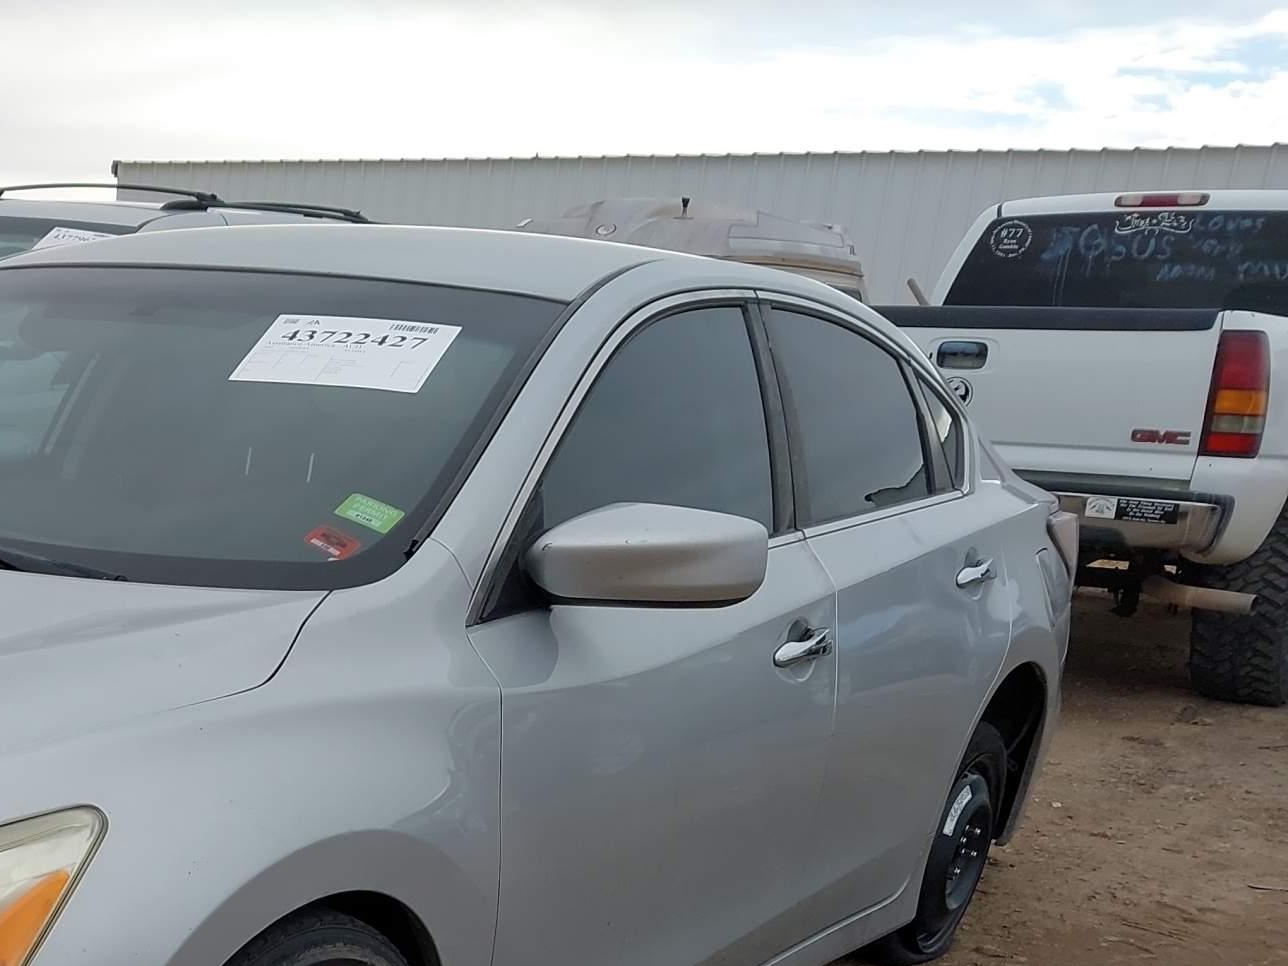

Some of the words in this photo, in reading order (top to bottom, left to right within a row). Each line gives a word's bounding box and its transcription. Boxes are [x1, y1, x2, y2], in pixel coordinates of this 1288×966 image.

[999, 227, 1024, 239] #77
[281, 328, 429, 350] 43722427
[1130, 430, 1192, 445] GMC
